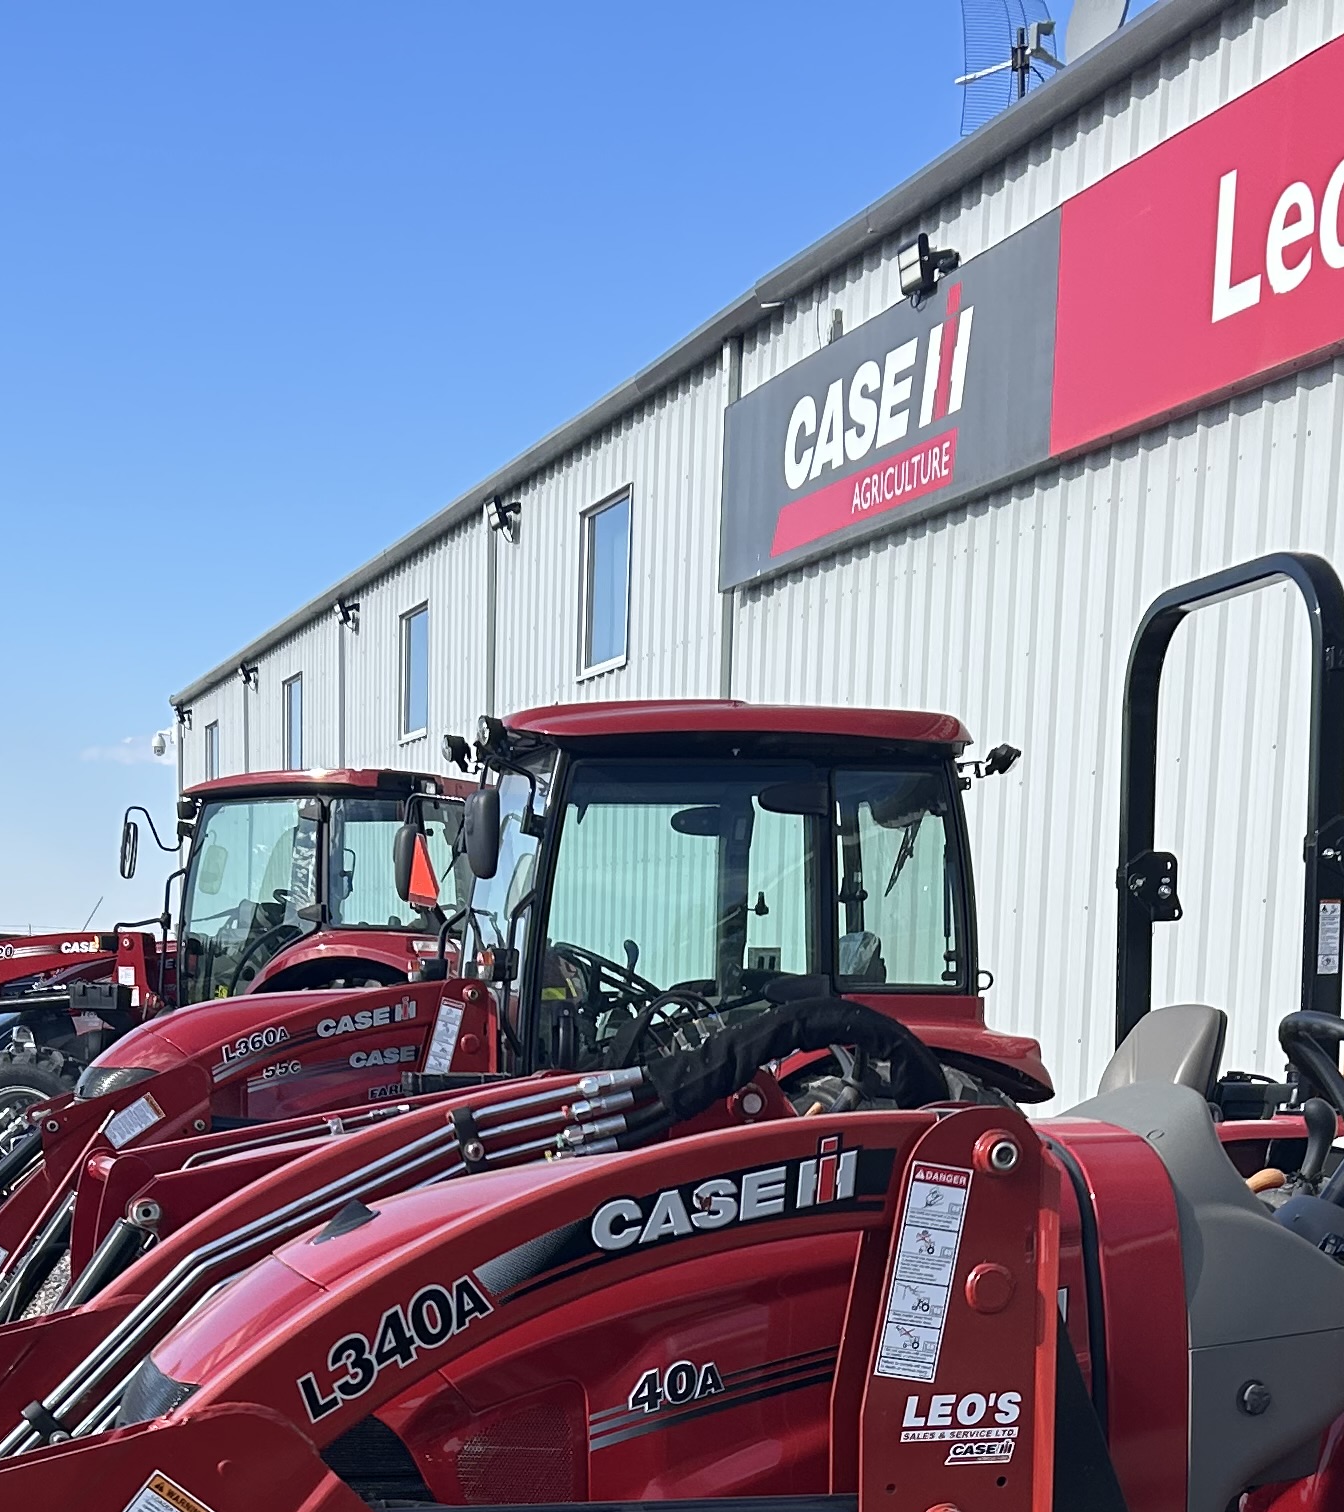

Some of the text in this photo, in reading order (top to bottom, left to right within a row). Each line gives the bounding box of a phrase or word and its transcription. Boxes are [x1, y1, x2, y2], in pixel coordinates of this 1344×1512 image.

[784, 337, 918, 490] CASE
[851, 441, 950, 514] AGRICULTURE
[60, 941, 99, 954] CASE
[317, 1007, 390, 1037] CASE
[222, 1026, 290, 1064] L360A
[349, 1046, 415, 1068] CASE
[263, 1060, 302, 1079] 55C
[925, 1170, 967, 1186] DANGER
[591, 1166, 787, 1251] CASE
[297, 1275, 494, 1424] L340A
[627, 1360, 726, 1414] 40A
[902, 1391, 1023, 1427] LEO'S
[903, 1432, 935, 1441] SALES
[937, 1431, 946, 1440] &
[949, 1429, 993, 1438] SERVICE
[952, 1445, 995, 1455] CASE
